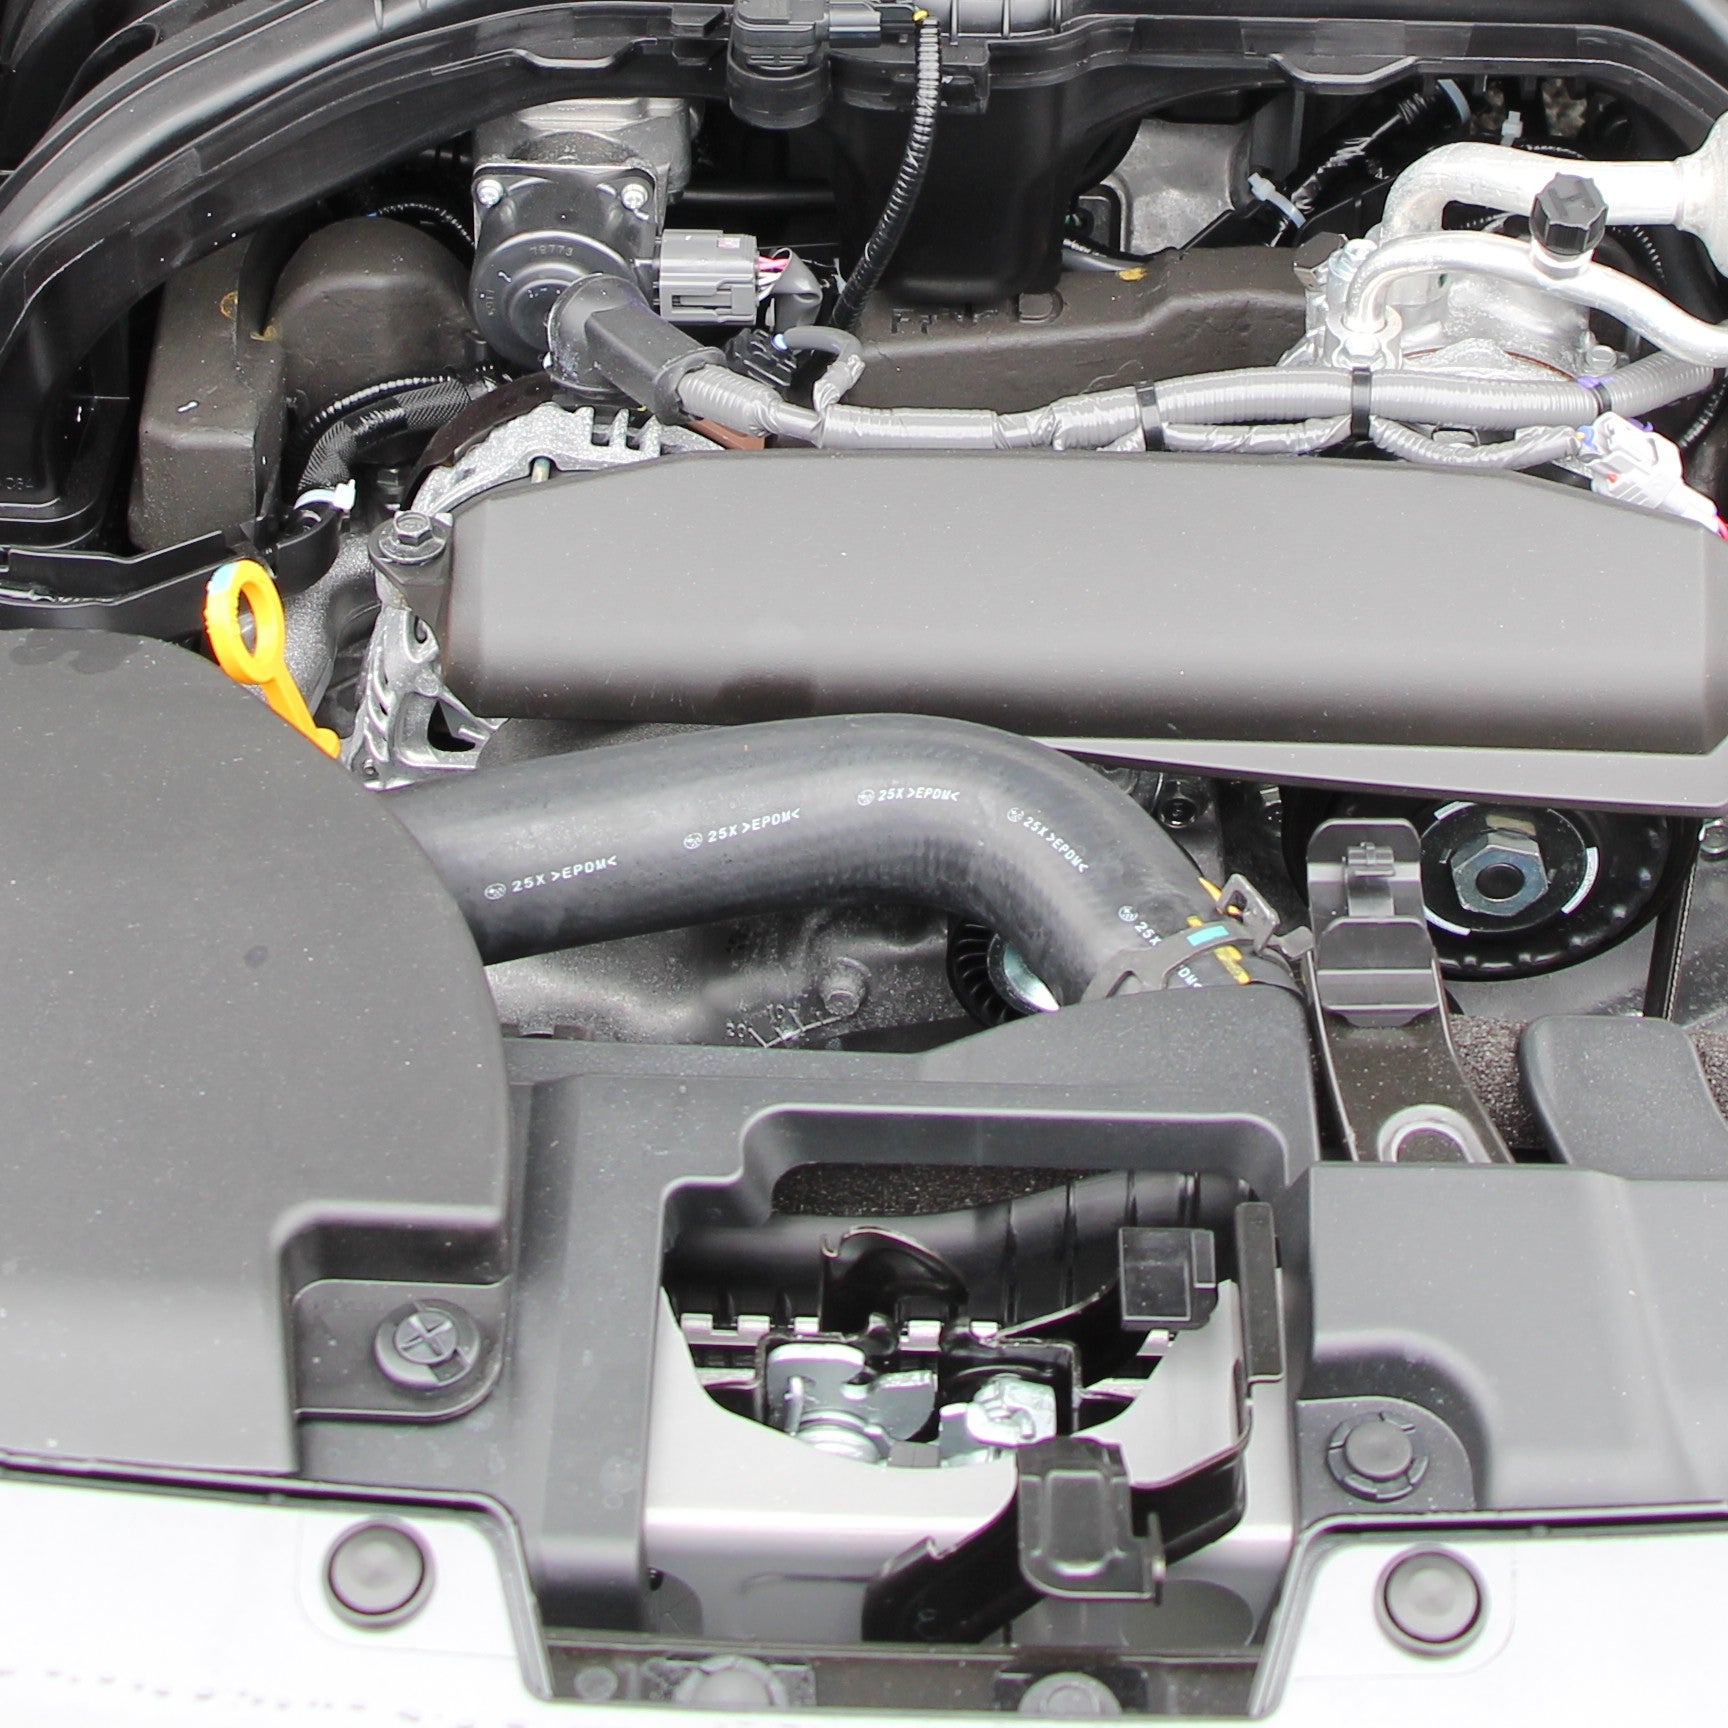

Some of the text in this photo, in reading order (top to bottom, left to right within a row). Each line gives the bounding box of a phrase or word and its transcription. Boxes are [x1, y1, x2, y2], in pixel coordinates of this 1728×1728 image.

[876, 786, 905, 803] 25X
[706, 824, 739, 845] 25X
[1022, 812, 1049, 837] 25X
[510, 873, 546, 893] 25X
